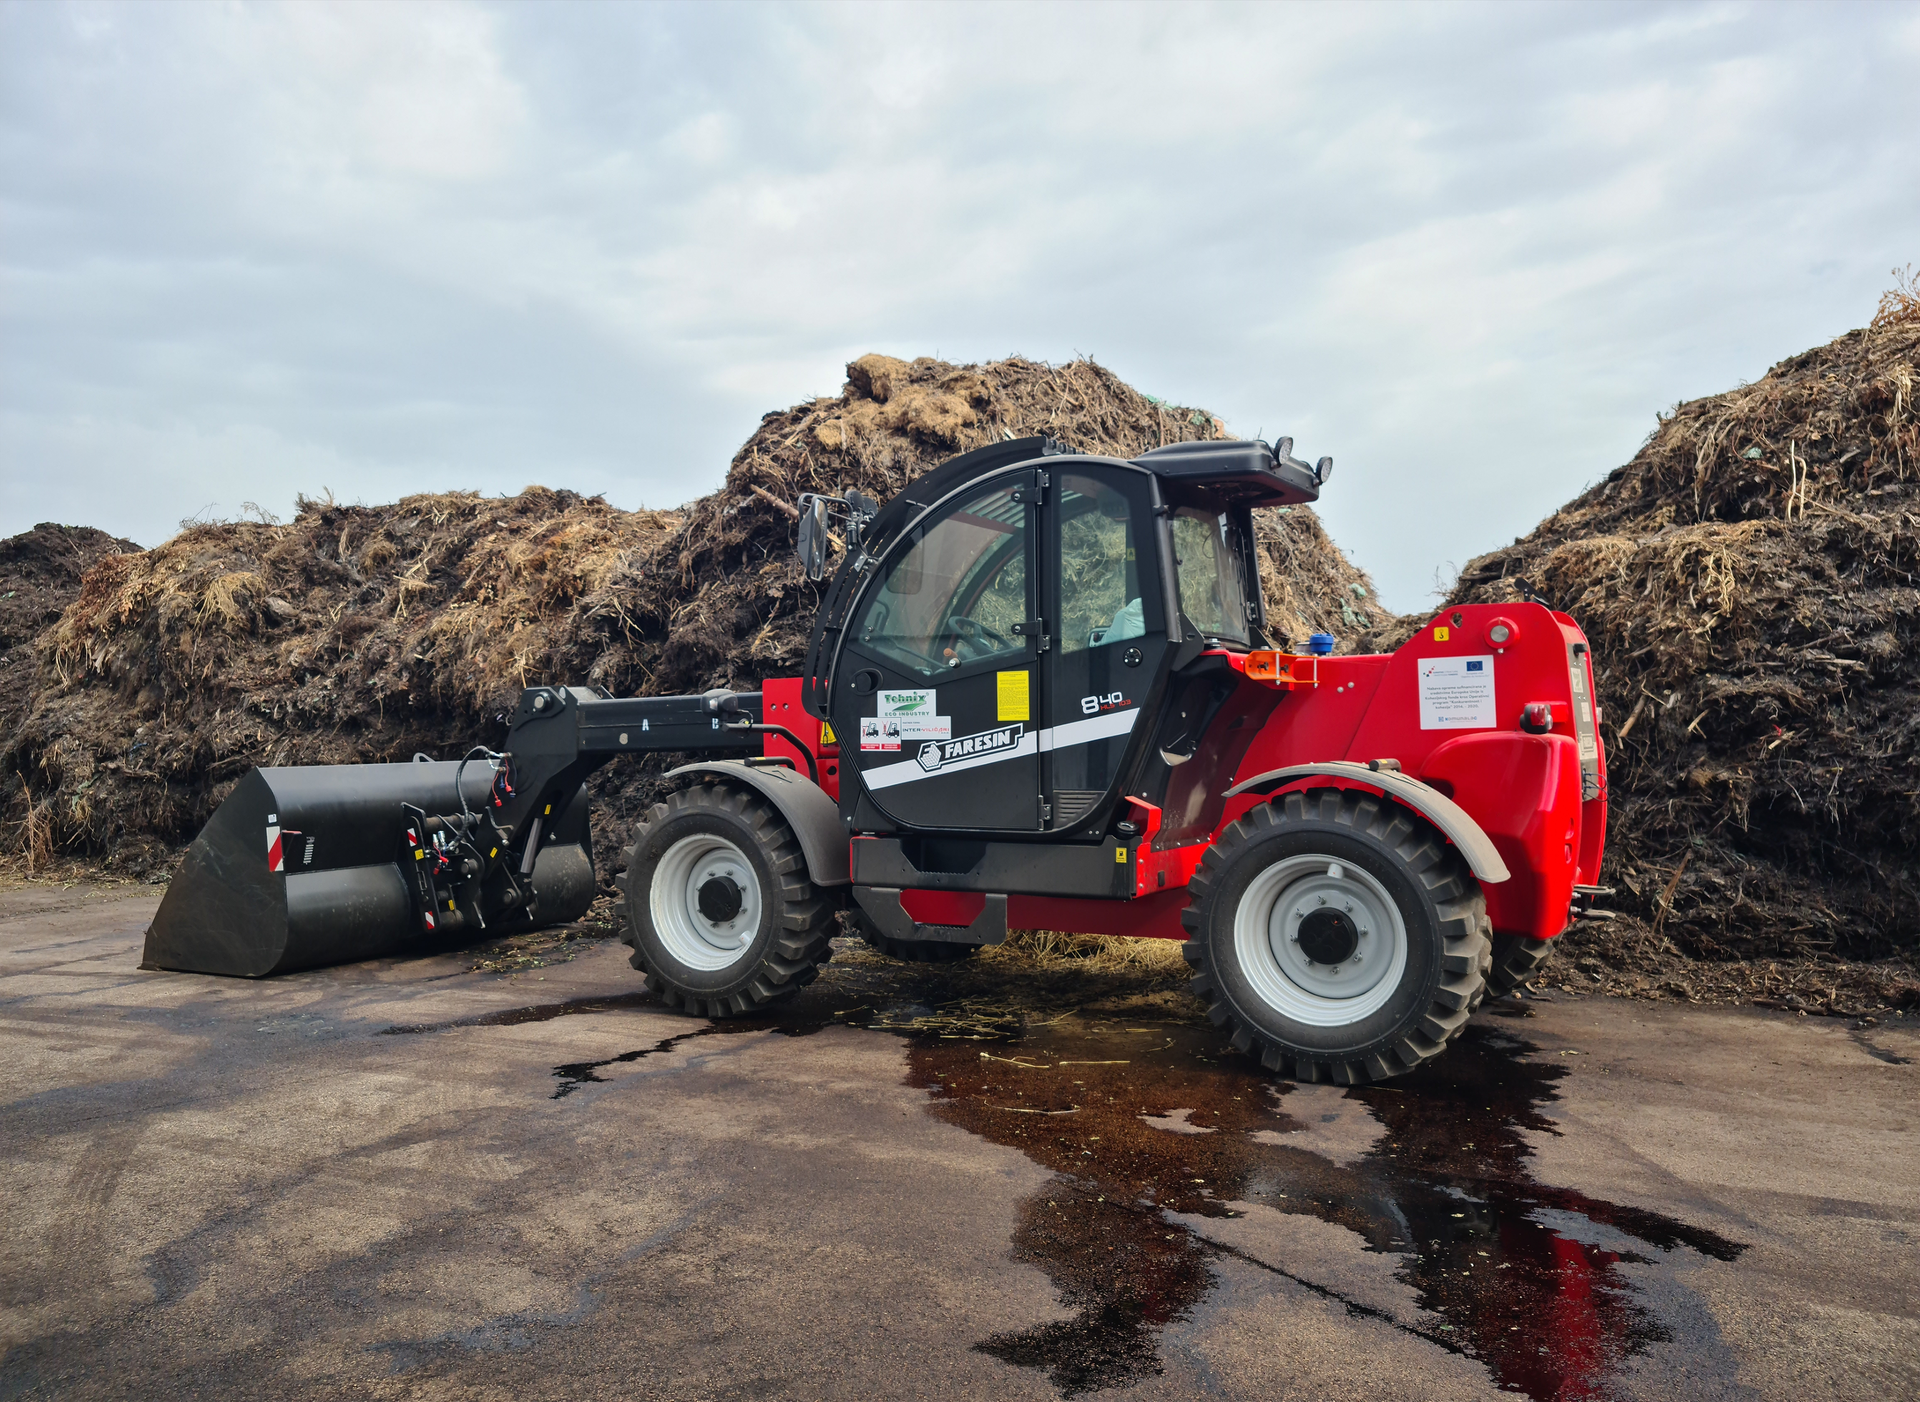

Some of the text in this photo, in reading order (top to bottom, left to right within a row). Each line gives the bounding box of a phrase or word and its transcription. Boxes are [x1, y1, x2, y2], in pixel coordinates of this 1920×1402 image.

[1081, 692, 1123, 714] 840
[642, 719, 649, 731] A
[712, 718, 719, 729] B
[945, 730, 1010, 759] FARESIN
